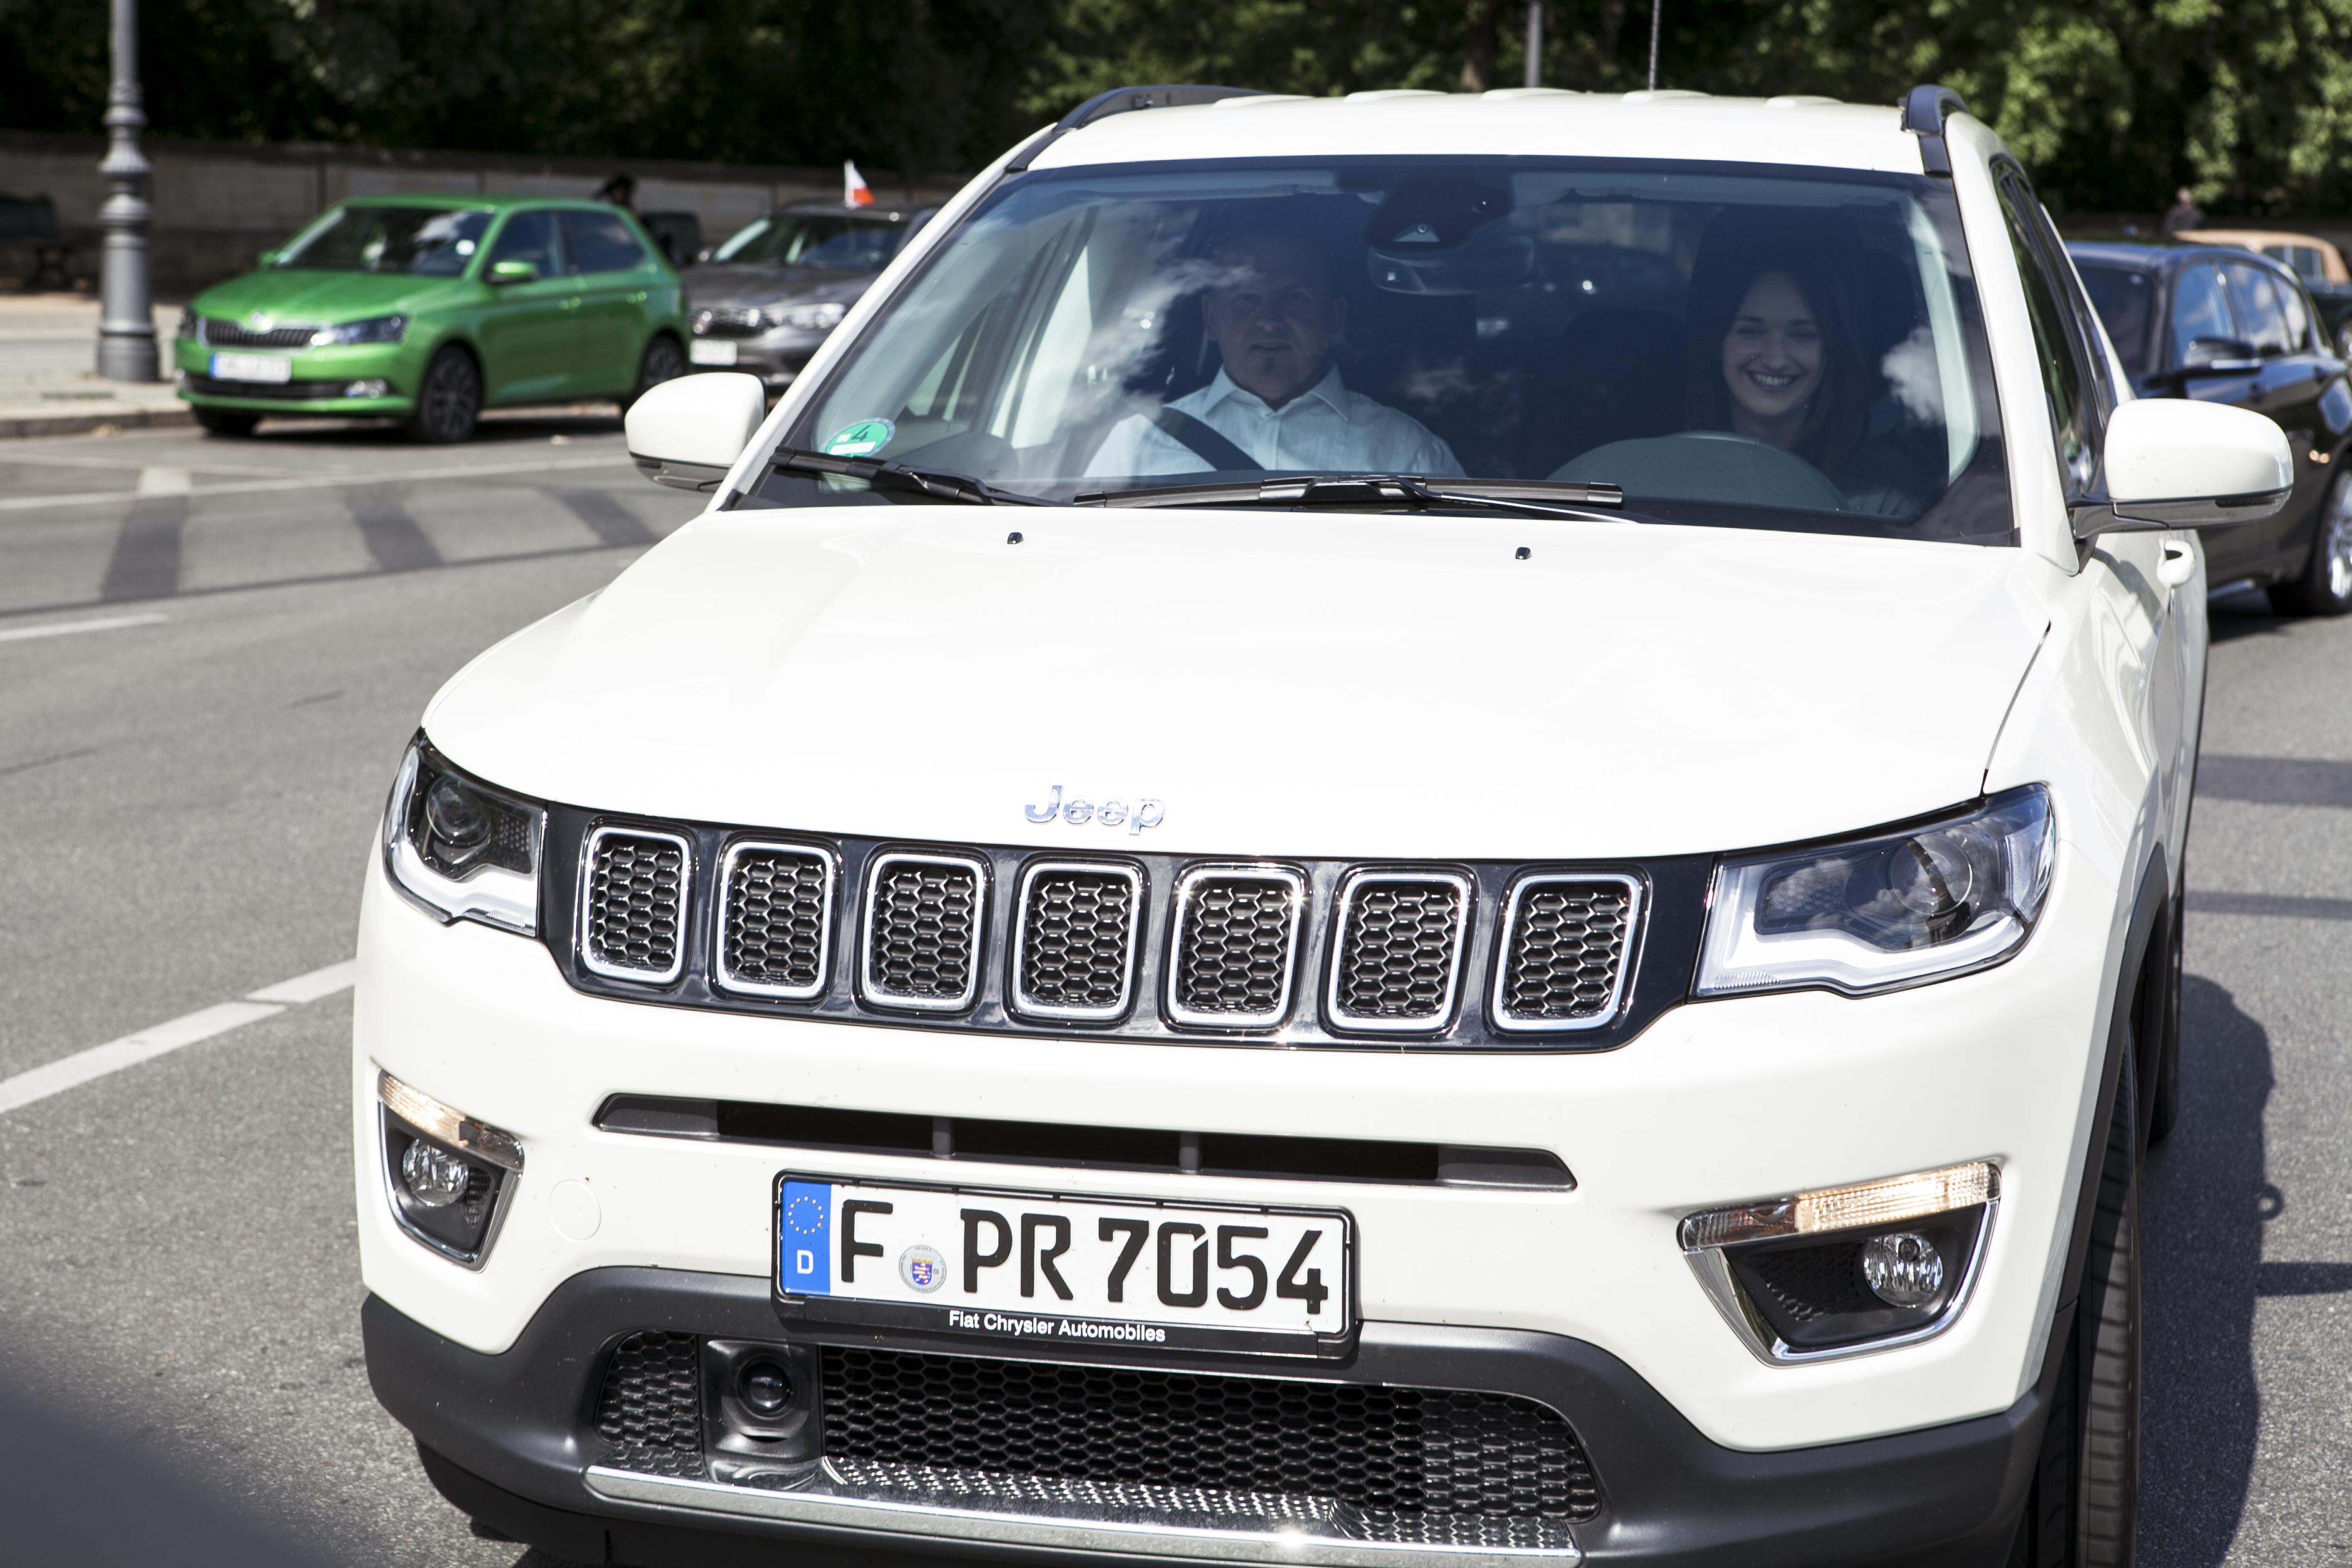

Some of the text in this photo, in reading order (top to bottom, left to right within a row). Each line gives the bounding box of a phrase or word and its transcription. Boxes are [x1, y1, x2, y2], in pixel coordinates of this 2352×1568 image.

[851, 425, 871, 442] 4
[1024, 785, 1165, 836] Jeep
[796, 1249, 814, 1275] D
[841, 1199, 893, 1283] F
[960, 1208, 1074, 1301] PR
[1098, 1217, 1328, 1315] 7054
[949, 1310, 1166, 1342] Fiat Chrysler Automobiles
